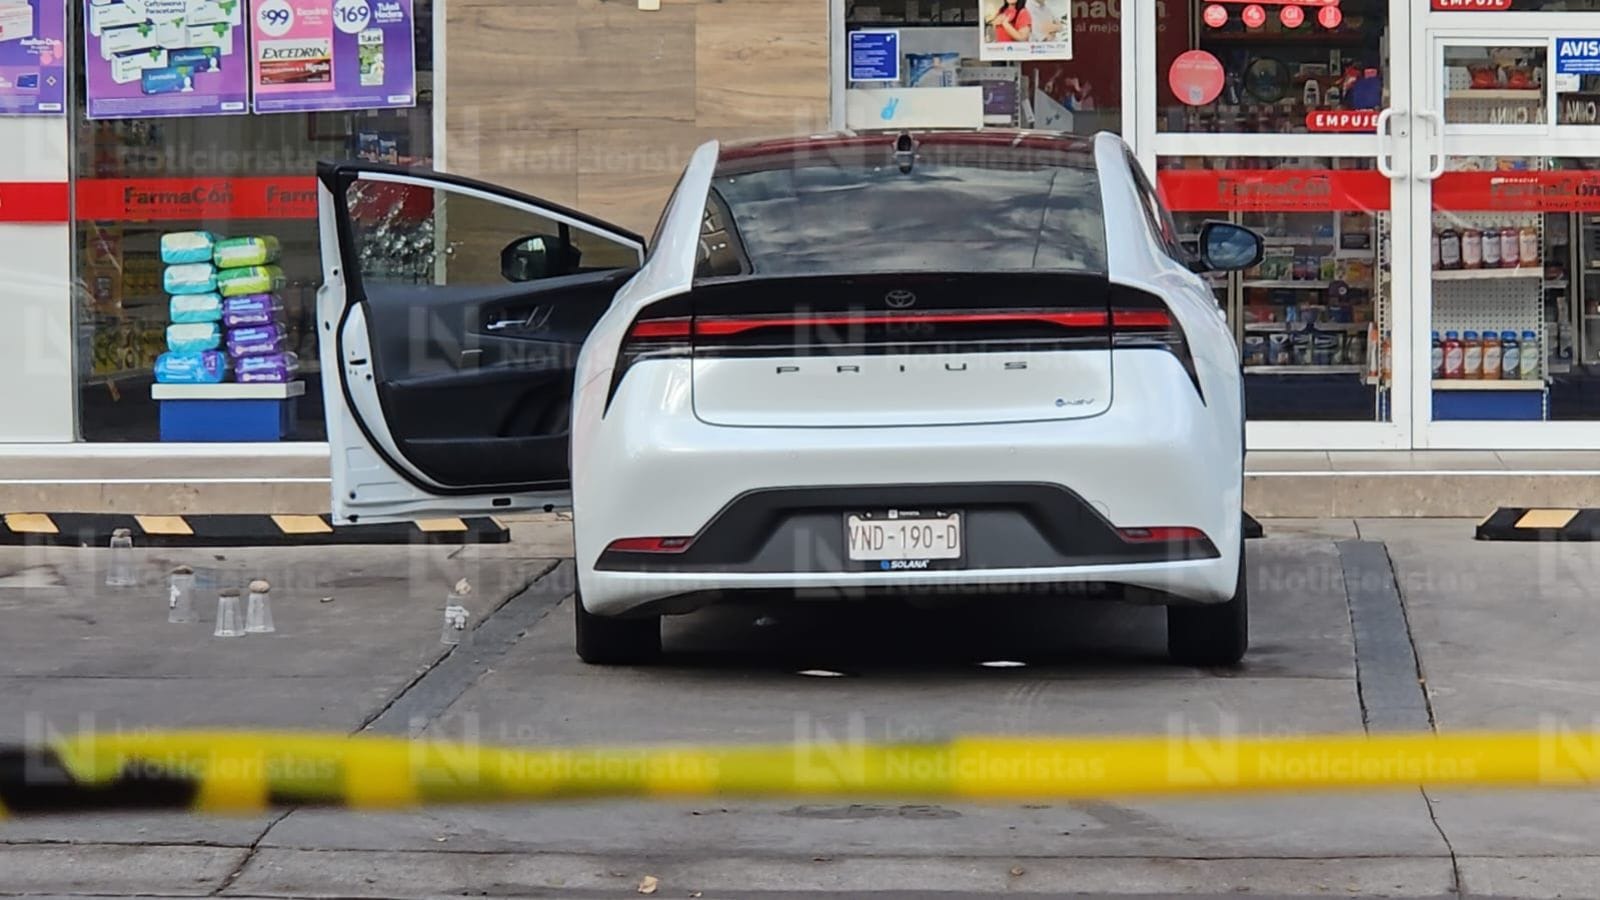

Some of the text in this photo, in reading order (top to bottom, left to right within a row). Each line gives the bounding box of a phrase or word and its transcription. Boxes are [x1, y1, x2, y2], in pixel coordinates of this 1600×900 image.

[261, 9, 289, 26] $99
[1089, 24, 1119, 34] mejo
[262, 47, 328, 59] EXCEDRIN
[1560, 41, 1600, 57] AVIS
[1315, 114, 1379, 127] EMPUJE
[776, 361, 1027, 374] PRIUS
[849, 525, 957, 551] VND-190-D
[890, 560, 928, 569] SOLANA
